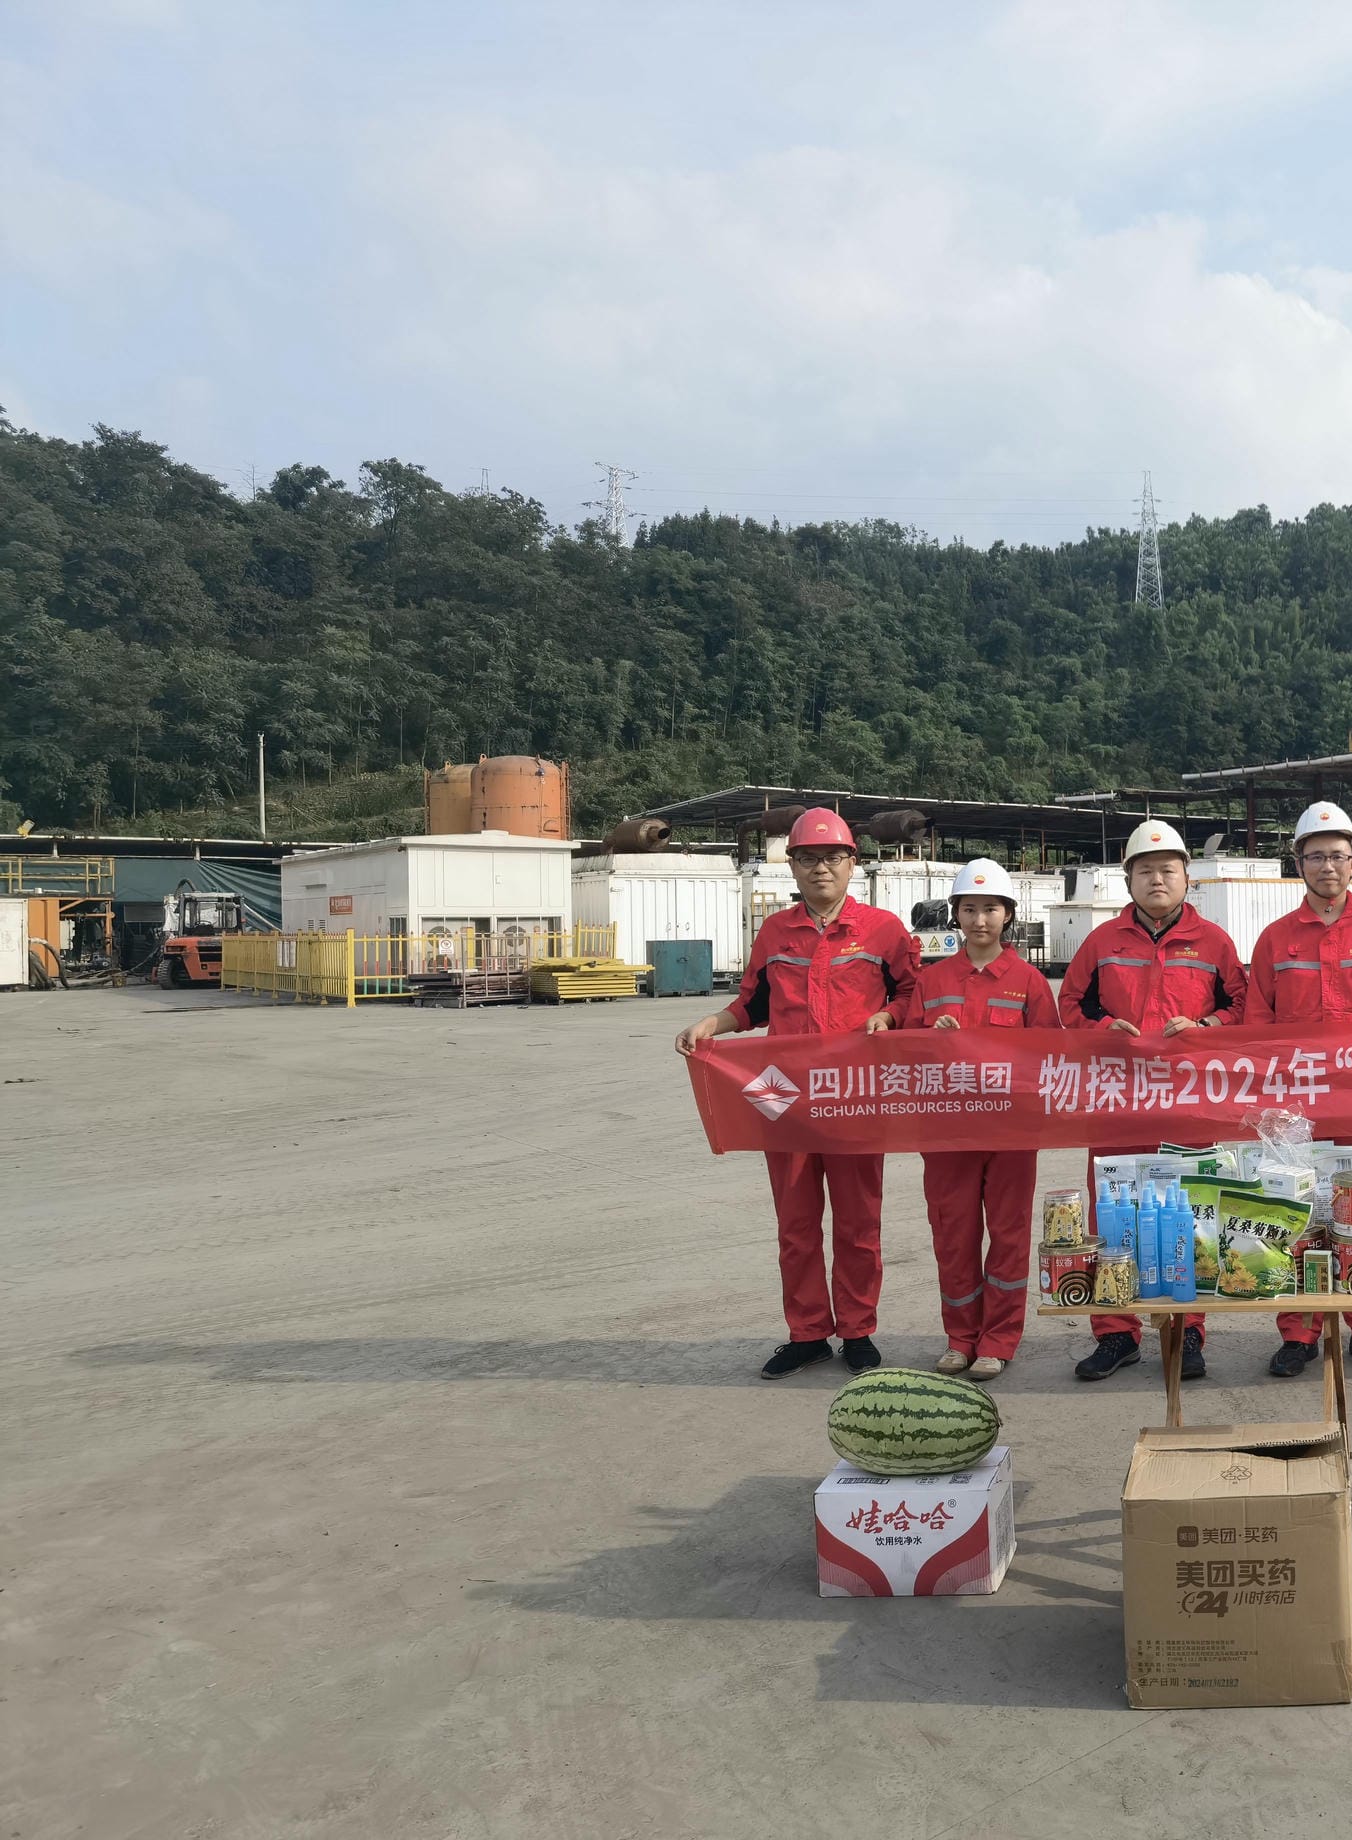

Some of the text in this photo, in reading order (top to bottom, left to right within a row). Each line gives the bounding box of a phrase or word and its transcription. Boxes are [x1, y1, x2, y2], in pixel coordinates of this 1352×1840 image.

[808, 1061, 1013, 1100] 四川资源集团
[810, 1099, 1013, 1118] SICHUAN RESOURCES GROUP
[1103, 1166, 1117, 1174] 999
[845, 1499, 954, 1534] 娃哈哈
[874, 1535, 923, 1546] 饮用纯净水
[1175, 1558, 1297, 1589] 美团买药
[1193, 1590, 1297, 1618] 24 小时药店
